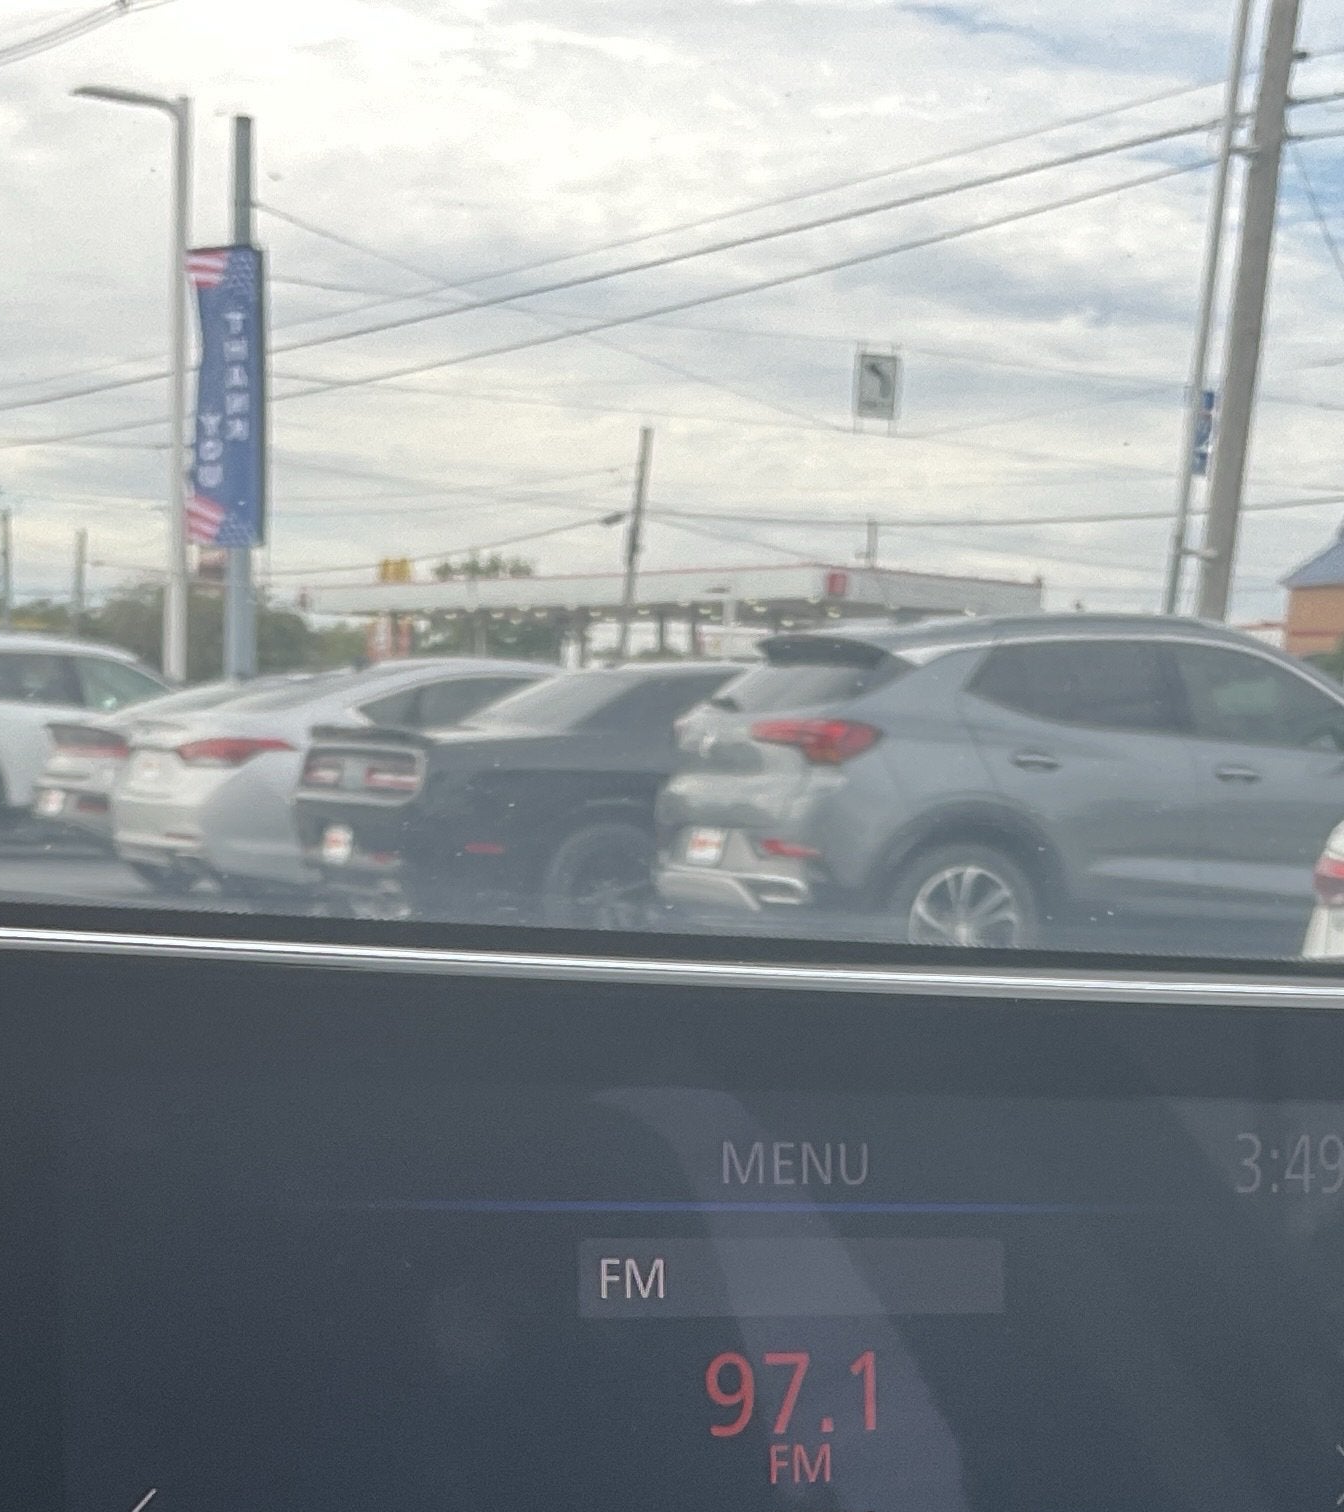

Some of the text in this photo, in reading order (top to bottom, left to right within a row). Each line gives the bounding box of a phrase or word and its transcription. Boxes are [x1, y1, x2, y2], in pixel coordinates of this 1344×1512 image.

[721, 1140, 869, 1187] MENU
[599, 1257, 666, 1300] FM
[705, 1351, 877, 1438] 97.1
[769, 1442, 832, 1485] FM
